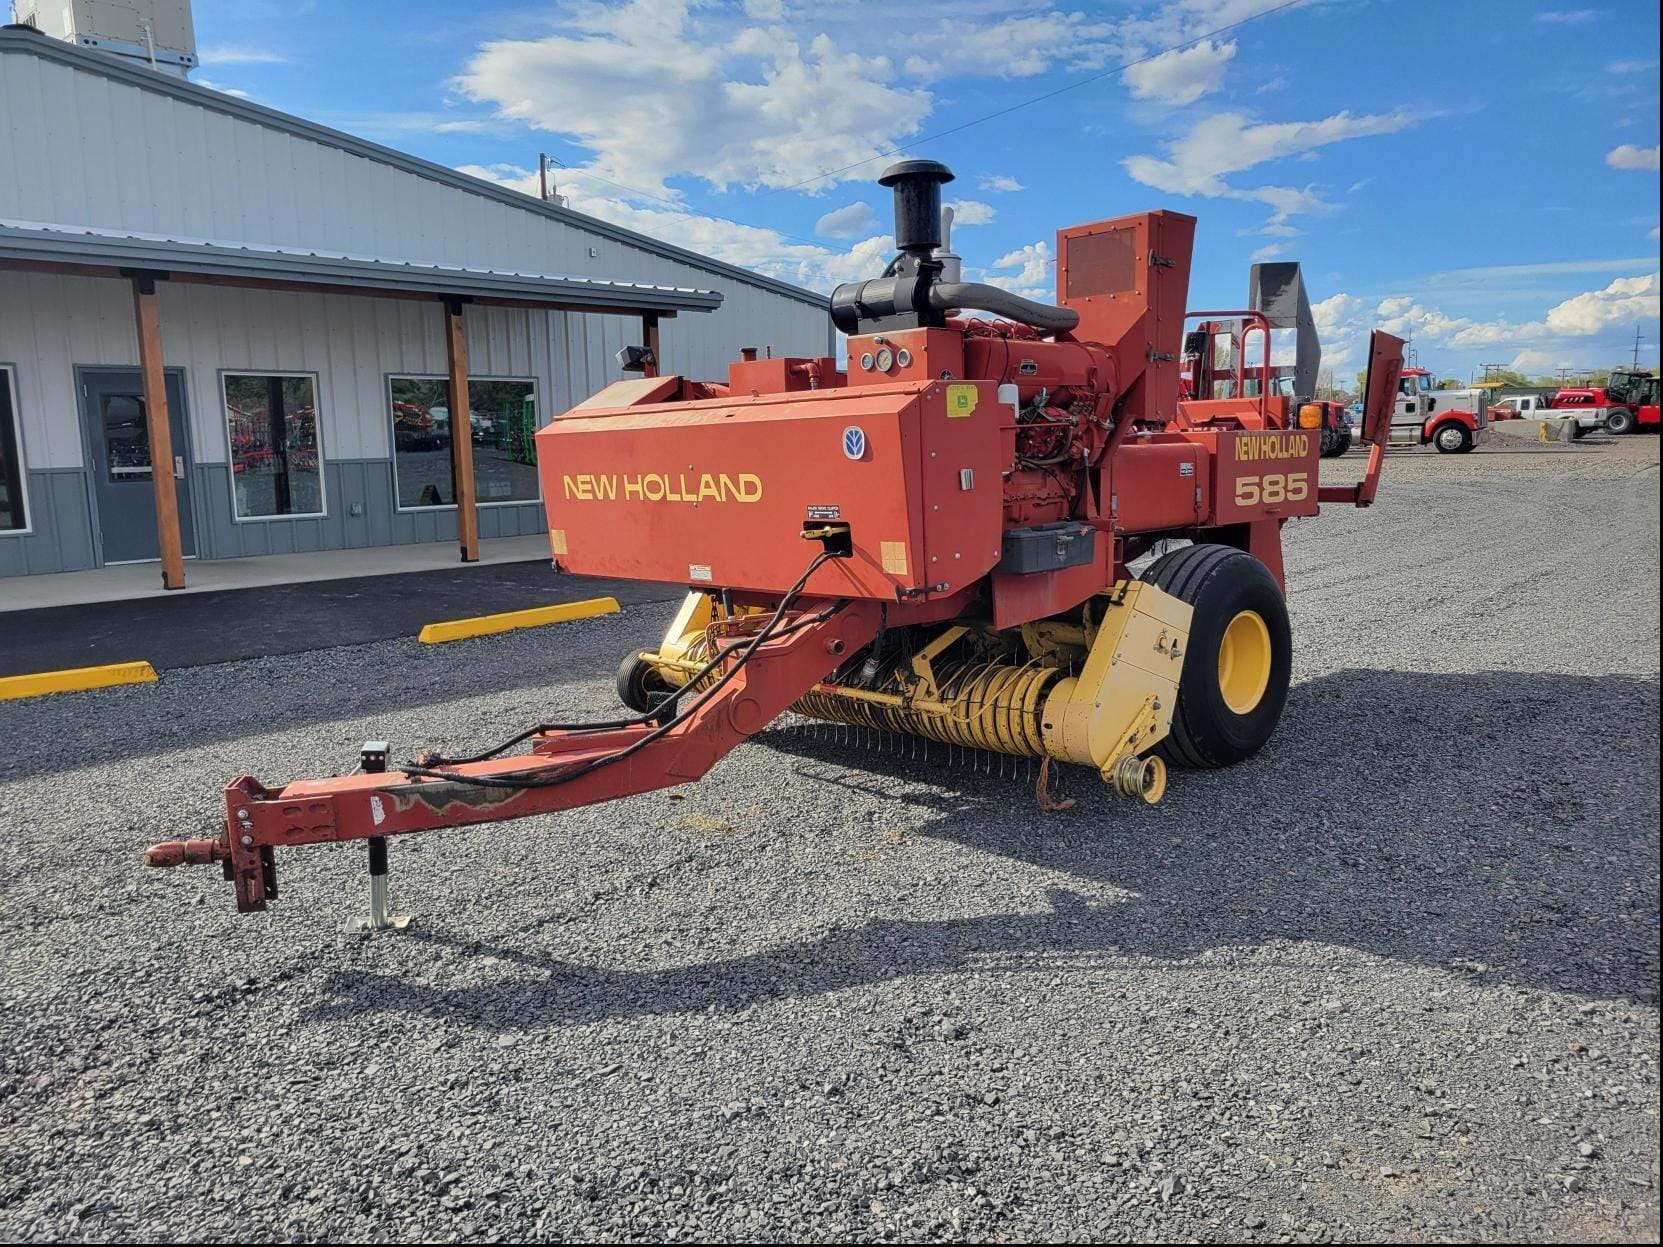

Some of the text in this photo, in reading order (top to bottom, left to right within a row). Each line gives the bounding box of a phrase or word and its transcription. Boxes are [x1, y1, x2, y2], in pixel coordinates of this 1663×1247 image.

[1235, 434, 1309, 461] NEW HOLLAND
[563, 473, 763, 503] NEW HOLLAND
[1235, 472, 1308, 506] 585
